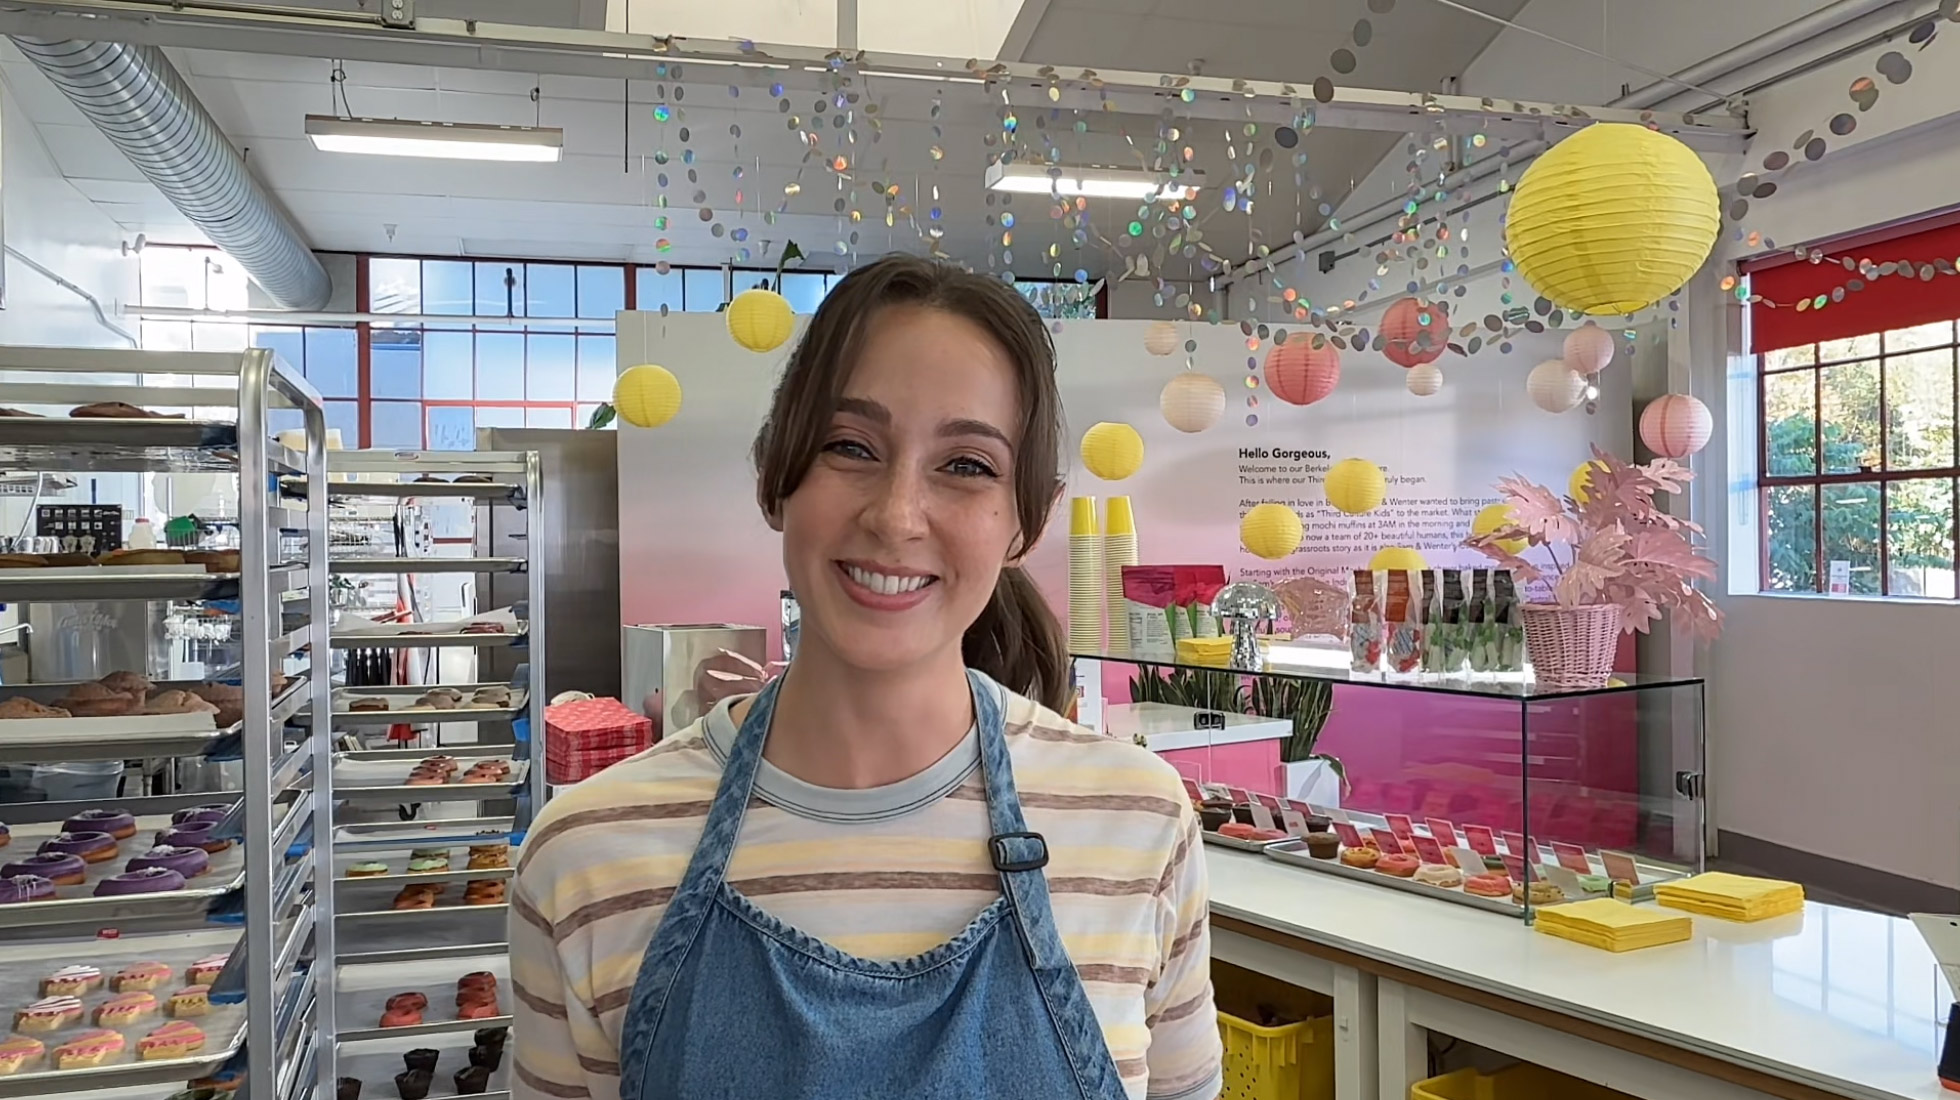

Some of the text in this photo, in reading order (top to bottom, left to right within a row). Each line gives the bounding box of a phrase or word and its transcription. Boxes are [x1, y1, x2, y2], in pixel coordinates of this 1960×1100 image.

[1239, 447, 1331, 461] Hello Gorgeous,
[1239, 464, 1277, 473] Welcome
[1279, 465, 1288, 473] to
[1305, 464, 1332, 473] Berkel
[1239, 475, 1256, 484] This
[1258, 475, 1265, 484] is
[1266, 475, 1290, 484] where
[1292, 476, 1306, 484] our
[1308, 475, 1325, 484] Thir
[1384, 475, 1399, 486] ruly
[1239, 499, 1259, 508] After
[1288, 499, 1296, 507] in
[1297, 498, 1315, 507] love
[1316, 499, 1324, 507] in
[1381, 497, 1388, 506] &
[1389, 498, 1418, 506] Wenter
[1420, 497, 1448, 506] wanted
[1450, 498, 1459, 506] to
[1459, 497, 1480, 508] bring
[1406, 508, 1420, 517] the
[1451, 508, 1473, 517] What
[1312, 520, 1337, 530] mochi
[1338, 520, 1367, 530] muffins
[1367, 521, 1376, 529] at
[1377, 519, 1396, 529] 3AM
[1398, 520, 1406, 528] in
[1407, 519, 1420, 528] the
[1421, 519, 1454, 530] morning
[1456, 519, 1471, 528] and
[1305, 533, 1323, 541] now
[1331, 533, 1352, 541] team
[1353, 531, 1362, 541] of
[1363, 531, 1379, 541] 20+
[1381, 530, 1415, 541] beautiful
[1332, 545, 1351, 555] story
[1363, 544, 1369, 552] it
[1370, 543, 1378, 552] is
[1415, 541, 1422, 551] &
[1239, 567, 1272, 579] Starting
[1273, 566, 1291, 576] with
[1292, 566, 1306, 576] the
[1307, 565, 1340, 577] Original
